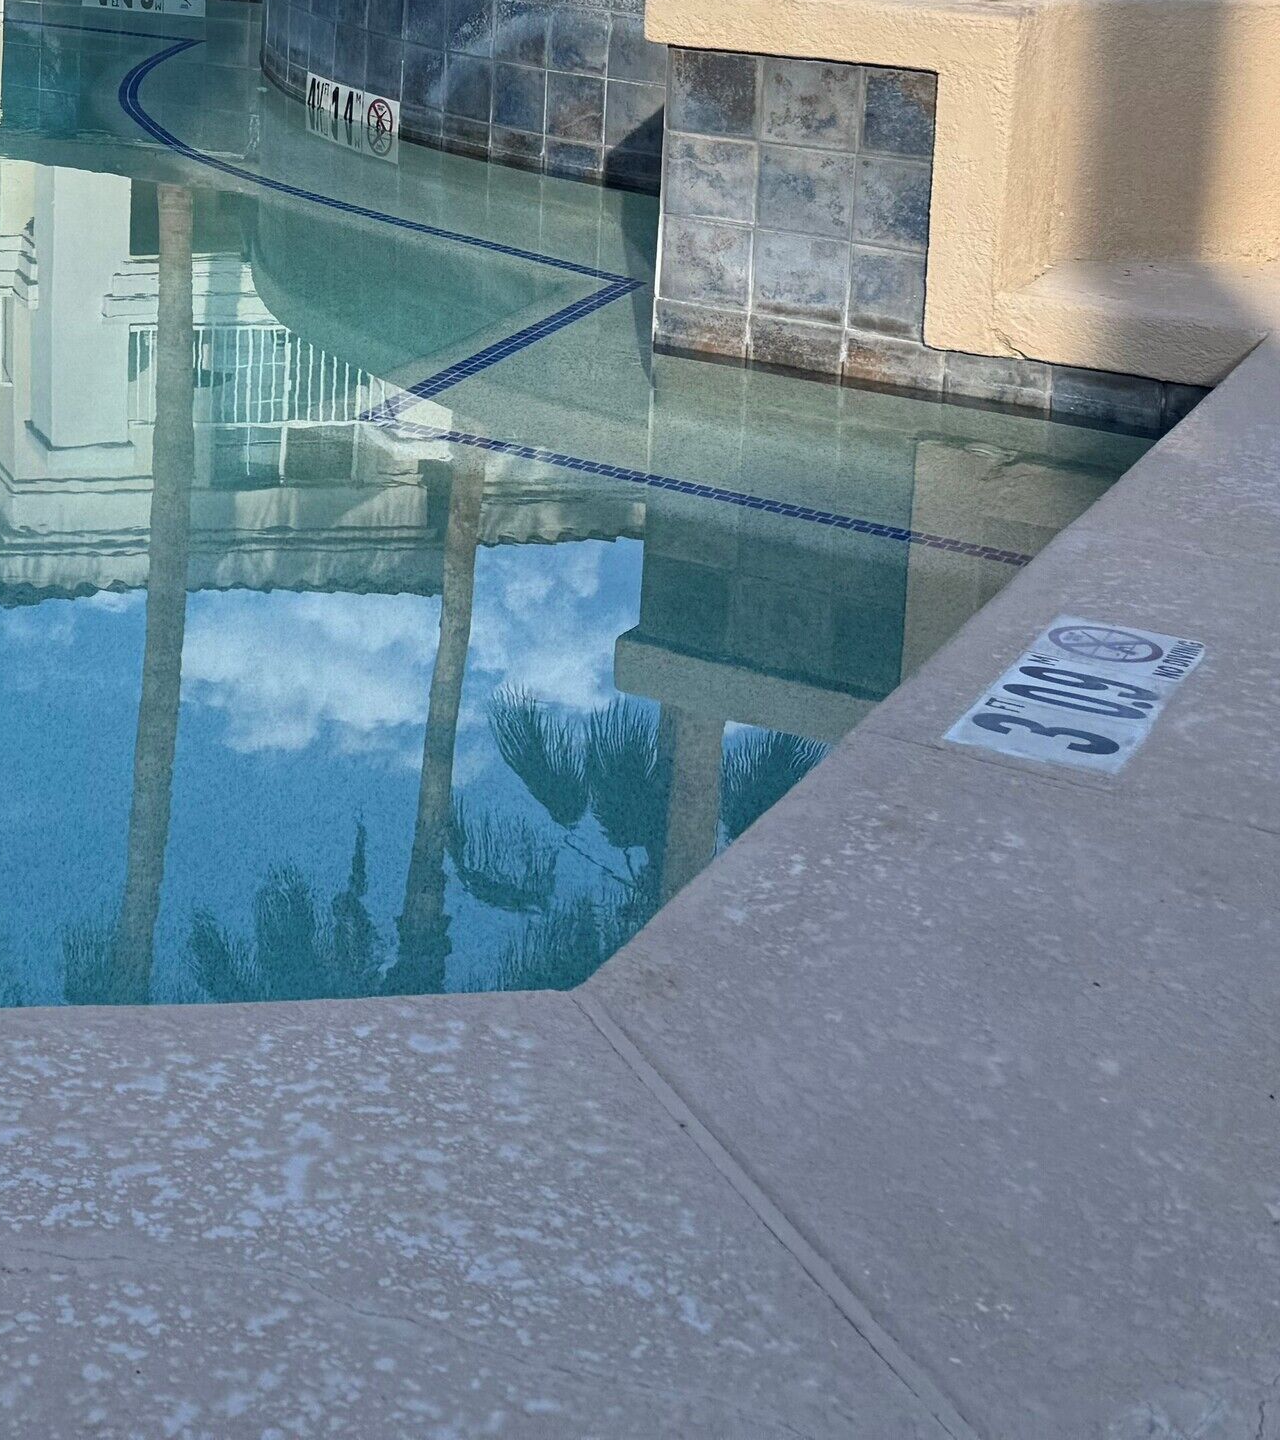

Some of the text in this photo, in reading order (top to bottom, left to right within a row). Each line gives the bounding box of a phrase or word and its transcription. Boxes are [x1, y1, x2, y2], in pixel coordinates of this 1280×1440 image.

[1152, 639, 1205, 680] NO DIVING
[985, 697, 1025, 713] FT
[1002, 665, 1161, 720] 0.9
[972, 712, 1120, 755] 3
